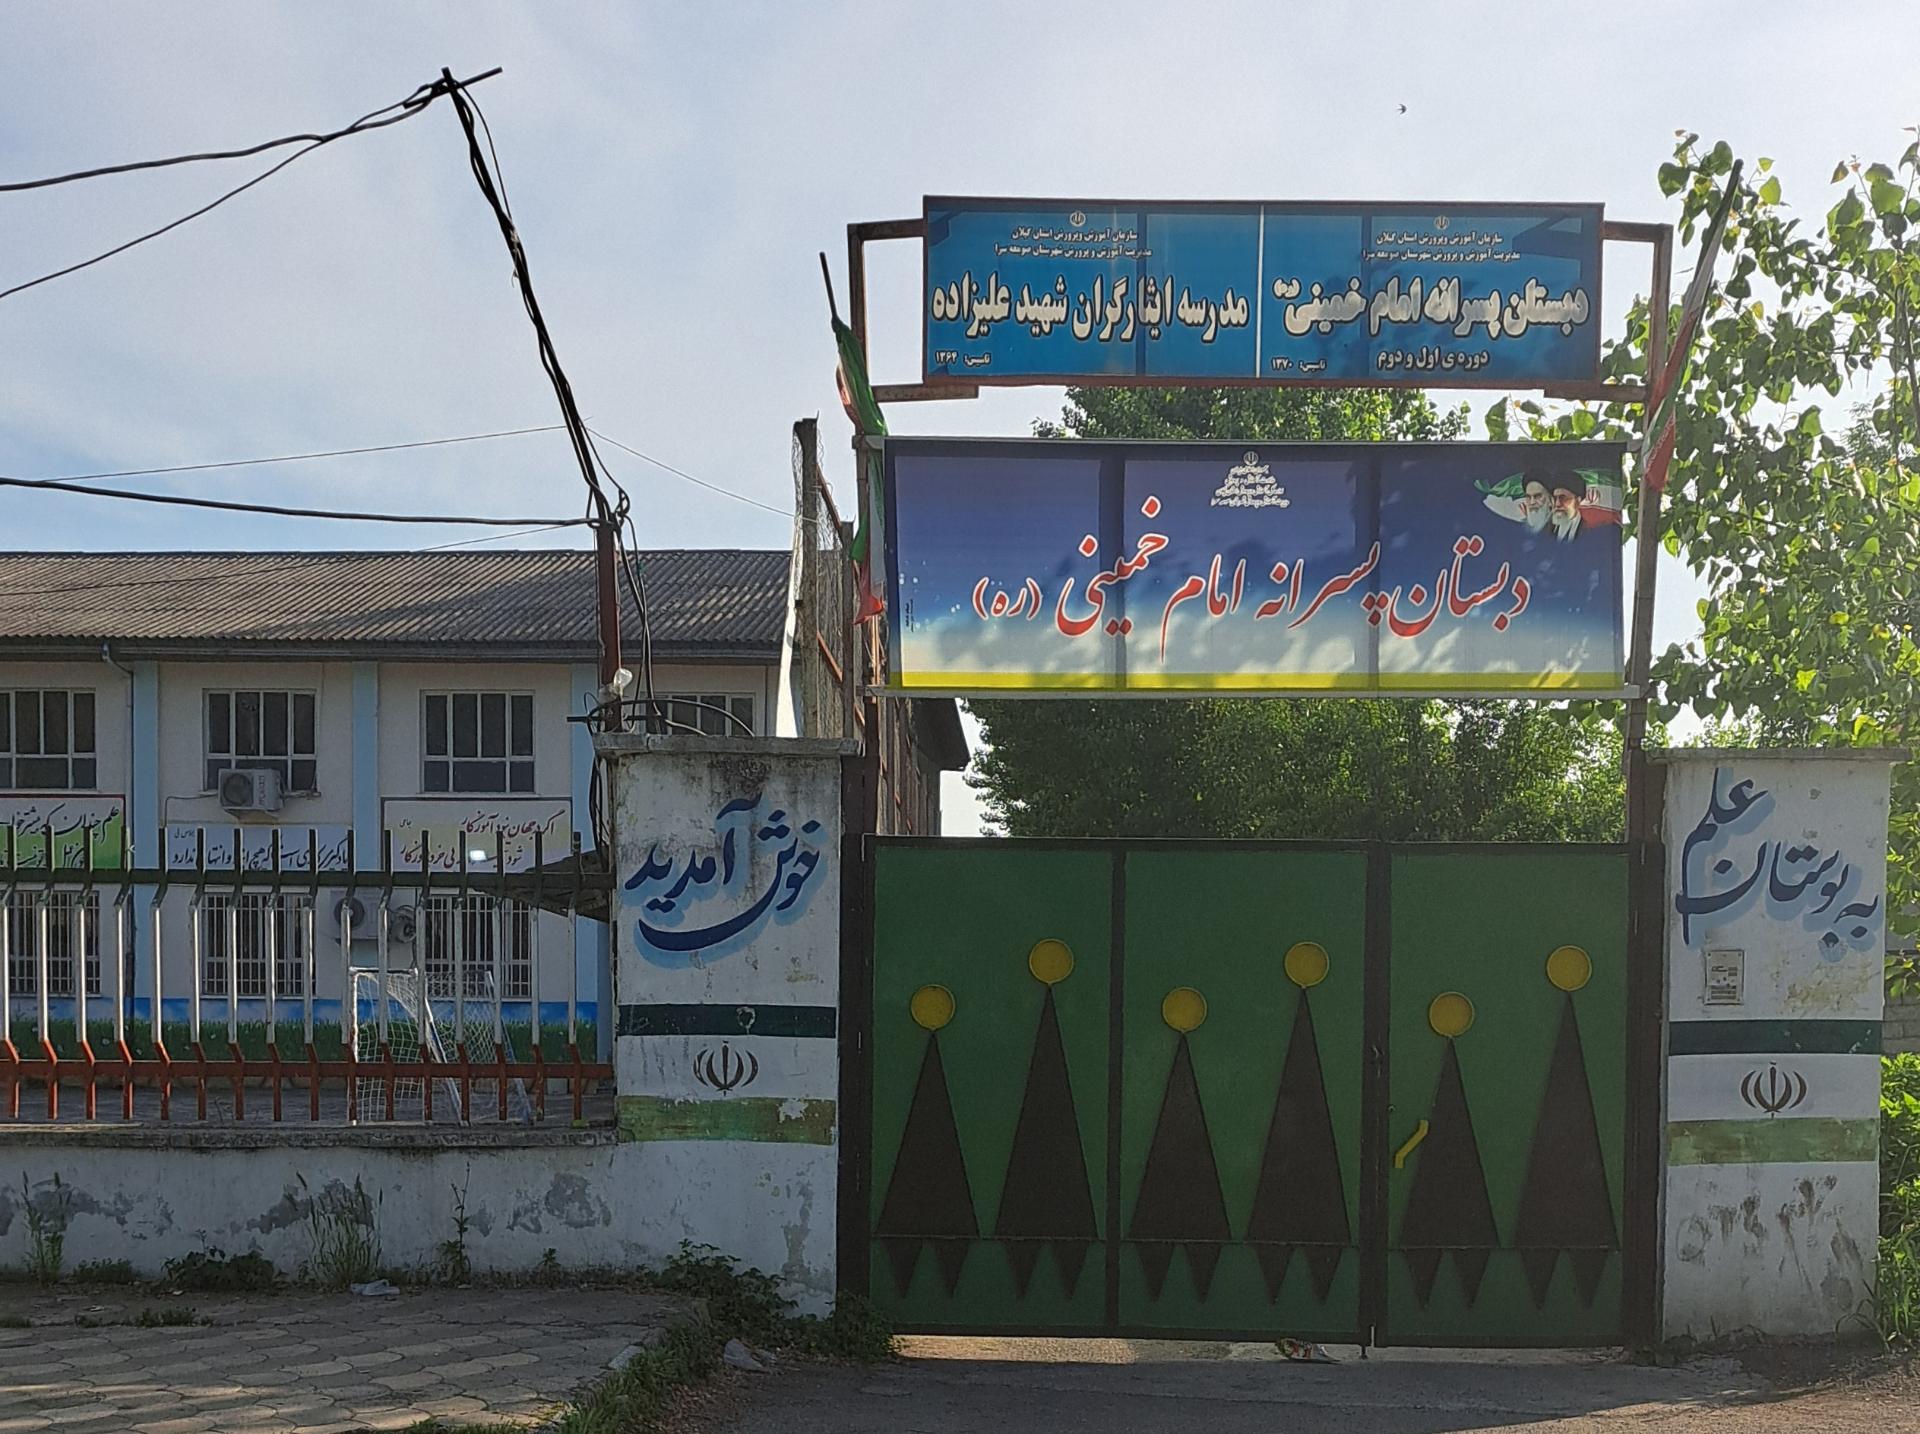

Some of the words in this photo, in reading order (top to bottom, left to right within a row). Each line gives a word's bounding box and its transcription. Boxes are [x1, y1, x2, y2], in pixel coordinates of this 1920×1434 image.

[1032, 227, 1052, 241] استان
[1083, 227, 1110, 243] آموزش
[1112, 229, 1138, 242] سازمان
[1397, 231, 1418, 245] استان
[1449, 230, 1477, 247] آموزش
[1477, 232, 1503, 246] سازمان
[931, 271, 1011, 338] علیزاده
[1014, 274, 1068, 338] شهید
[1176, 287, 1249, 342] مدرسه
[1283, 277, 1367, 337] خمینی
[1369, 276, 1422, 337] امام
[1423, 276, 1501, 339] پسرانه
[1503, 277, 1590, 337] دبستان
[1376, 349, 1403, 370] دوم
[1405, 354, 1414, 370] و
[1415, 346, 1440, 370] اول
[1054, 495, 1169, 638] خمینی
[1254, 540, 1389, 630] پسرانه
[1386, 535, 1532, 639] دبستان
[1159, 553, 1247, 665] امام
[624, 792, 765, 915] آمدید
[638, 808, 822, 952] خوش
